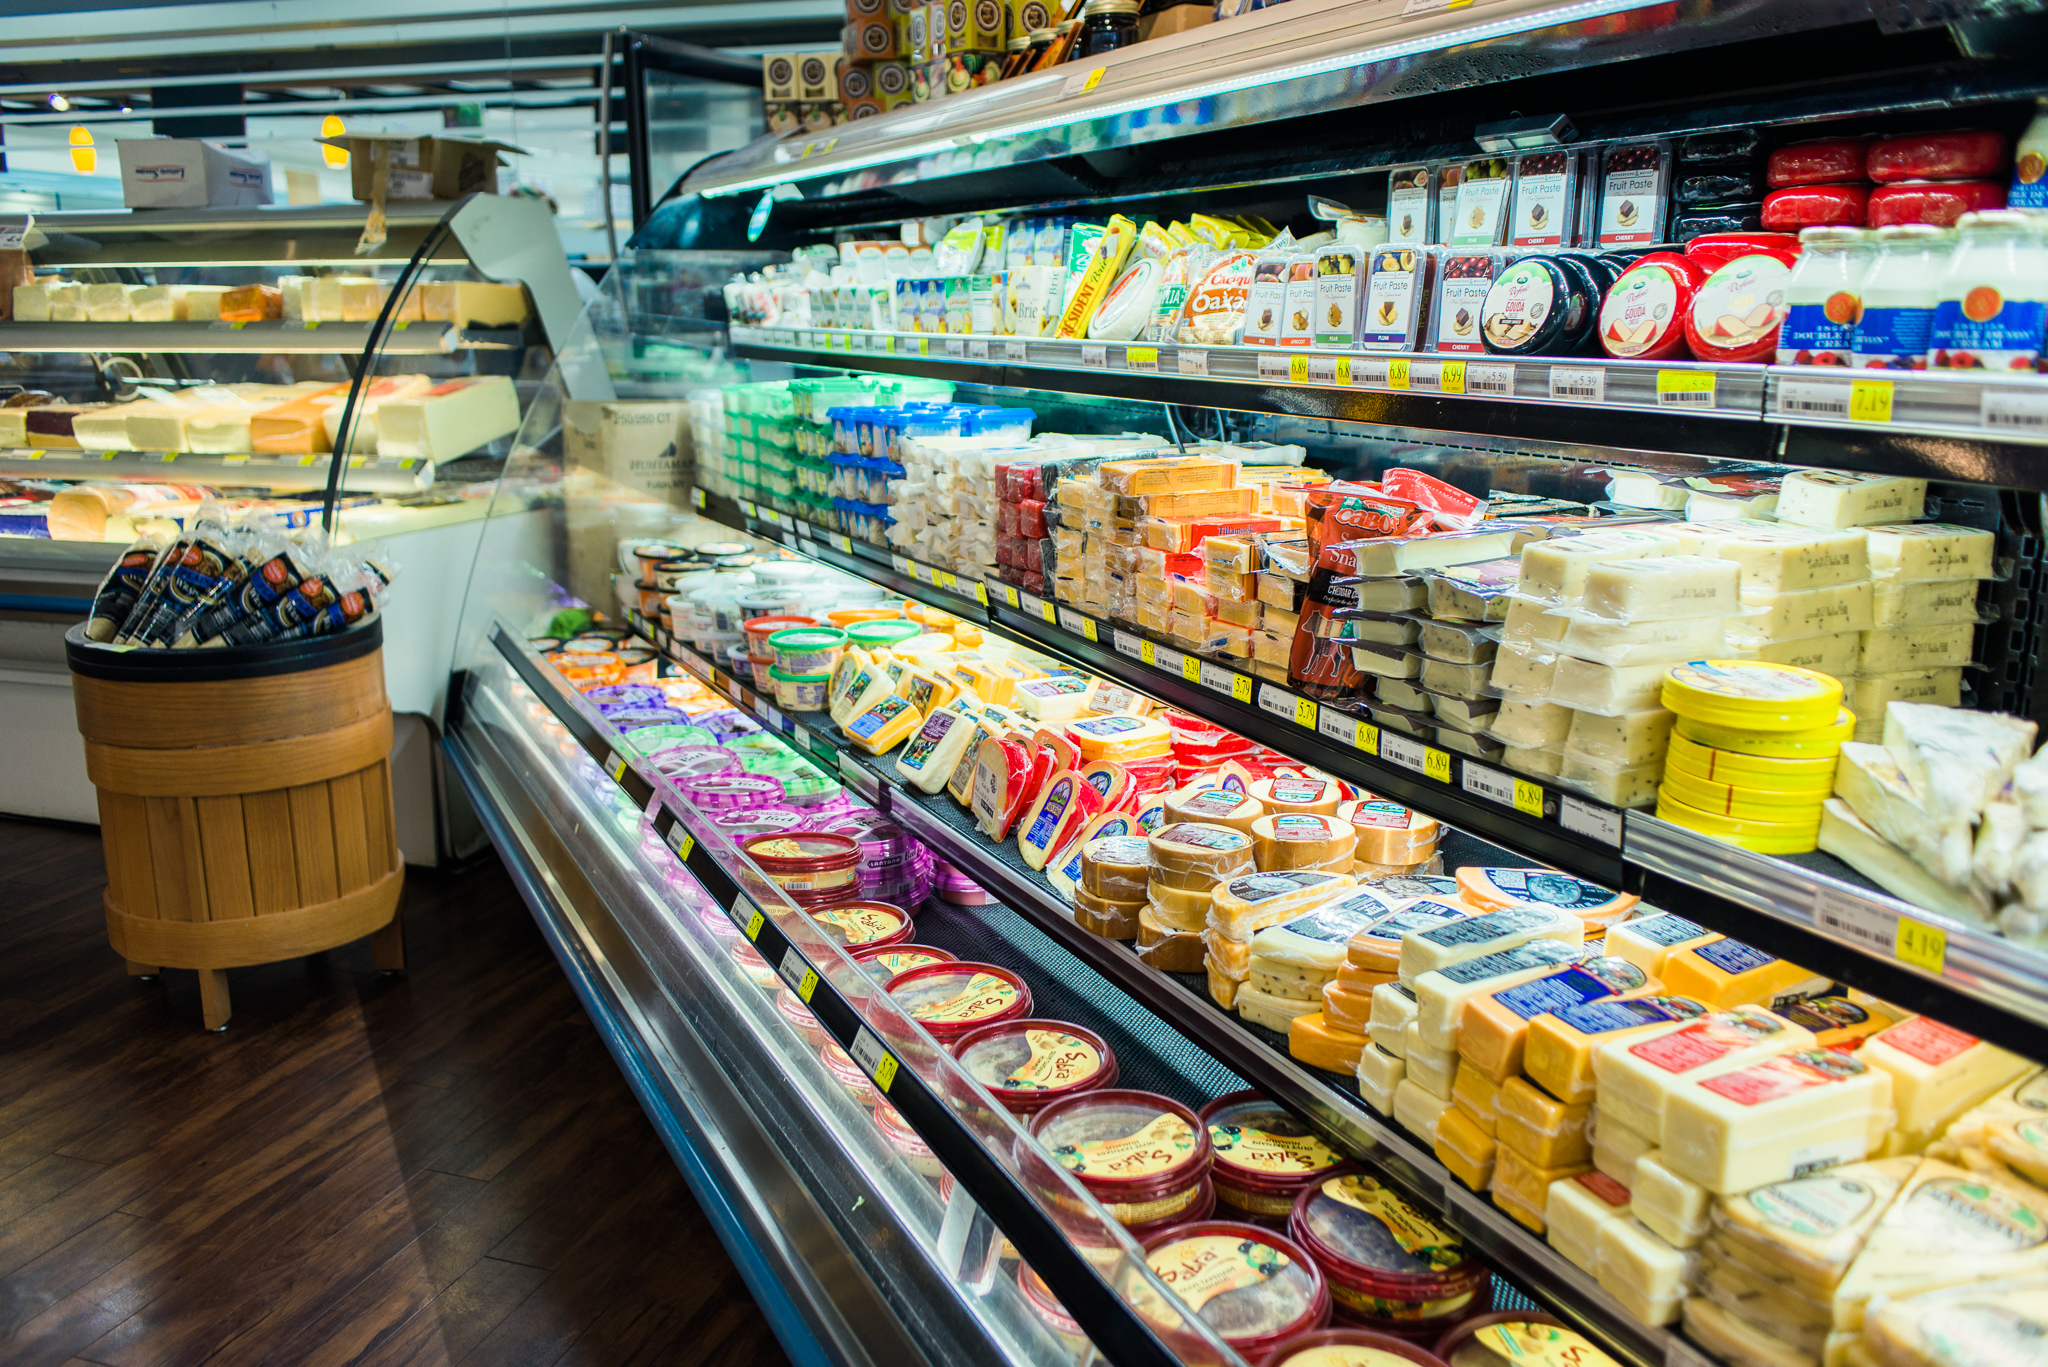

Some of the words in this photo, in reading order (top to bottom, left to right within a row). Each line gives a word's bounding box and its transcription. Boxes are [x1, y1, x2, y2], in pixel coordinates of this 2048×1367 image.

[1521, 185, 1539, 195] Fruit
[1540, 184, 1561, 194] Paste
[1609, 181, 1628, 191] Fruit
[1630, 179, 1653, 190] Paste
[1091, 259, 1108, 283] Brie
[1049, 270, 1060, 295] Brie
[1211, 273, 1251, 287] Caciqu
[1320, 283, 1334, 293] Fruit
[1336, 283, 1352, 293] Paste
[1373, 281, 1389, 291] Fruit
[1390, 280, 1408, 290] Paste
[1255, 289, 1271, 298] Fruit
[1289, 289, 1302, 298] Fruit
[1303, 289, 1315, 298] Pas
[1446, 287, 1462, 298] Fruit
[1464, 288, 1487, 297] Paste
[1018, 302, 1039, 319] Brie
[1192, 294, 1246, 313] Oaxa
[1505, 301, 1525, 312] GOUDA
[1624, 306, 1646, 320] GOUDA
[1814, 340, 1850, 348] CREA
[1291, 358, 1307, 375] 6.89
[1338, 361, 1350, 378] 6.8
[1389, 361, 1407, 380] 6.89
[1443, 364, 1462, 383] 6.99
[1491, 371, 1507, 382] 5.59
[1579, 375, 1597, 386] 5.39
[1692, 379, 1713, 390] 5.59
[1857, 388, 1889, 412] 7.19
[1217, 525, 1253, 536] Tillamook
[1329, 549, 1357, 568] Sna
[1083, 620, 1096, 639] 5.39
[1185, 658, 1200, 676] 5.39
[1235, 676, 1250, 696] 5.79
[1298, 701, 1315, 721] 5.79
[1359, 724, 1376, 746] 6.89
[1427, 750, 1447, 778] 6.89
[1518, 782, 1541, 808] 6.89
[871, 858, 900, 868] LANTANA
[860, 913, 887, 932] Sabra
[1903, 928, 1942, 959] 4.19
[802, 972, 817, 993] 5.79
[957, 996, 1004, 1019] Sabra
[880, 1056, 895, 1082] 5.79
[1054, 1051, 1088, 1079] Sabra
[1105, 1139, 1140, 1151] HUMMUS
[1252, 1140, 1290, 1149] TAPENADE
[1265, 1137, 1301, 1145] HUMMUS
[1291, 1143, 1314, 1152] OLIVE
[1107, 1149, 1173, 1171] Sabra
[1251, 1150, 1315, 1170] Sabra
[1156, 1250, 1218, 1283] Sabra
